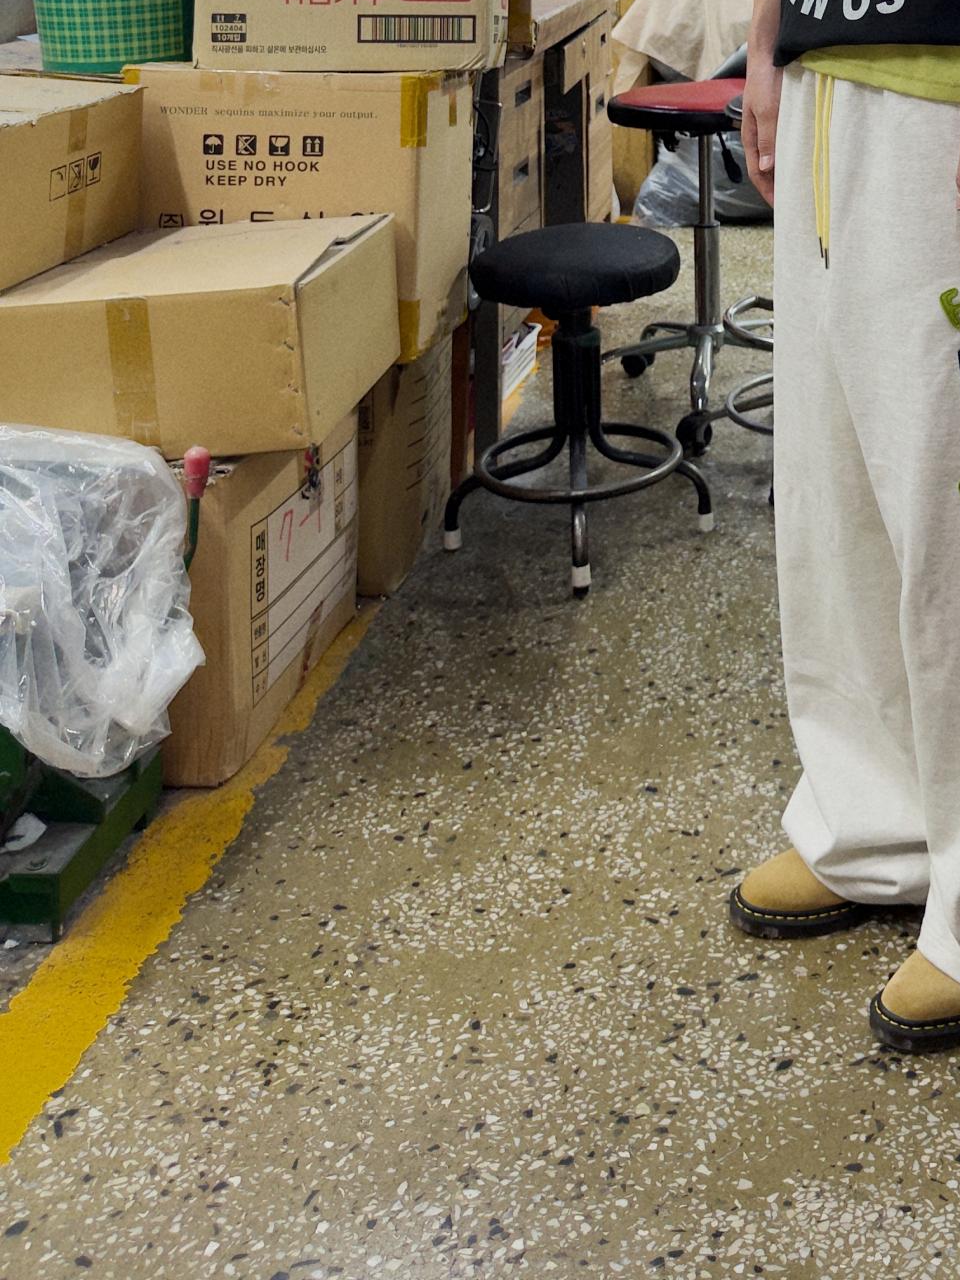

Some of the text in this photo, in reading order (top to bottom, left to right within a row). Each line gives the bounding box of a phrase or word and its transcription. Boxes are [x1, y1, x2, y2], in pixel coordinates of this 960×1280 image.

[159, 106, 208, 116] WONDER
[214, 108, 255, 120] sequins
[258, 107, 310, 119] maximize
[312, 110, 336, 120] your
[206, 160, 320, 172] USE NO HOOK
[205, 175, 288, 187] KEEP DRY
